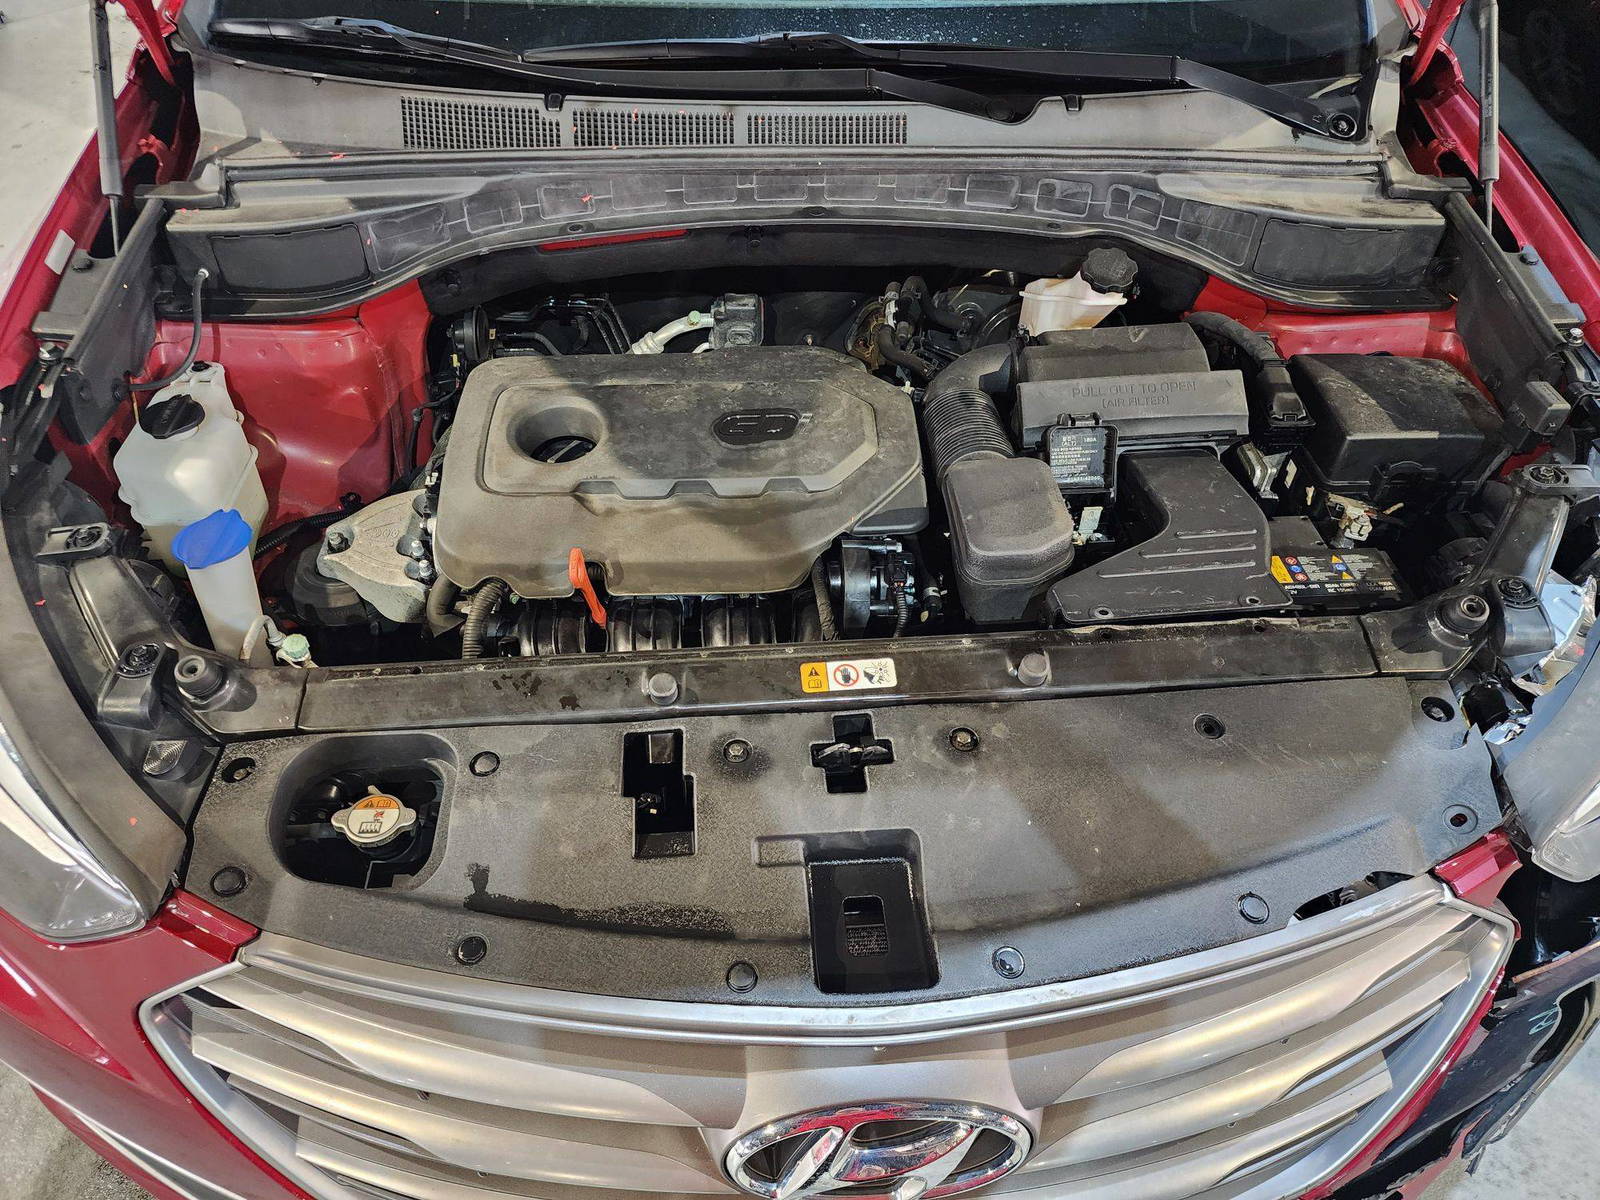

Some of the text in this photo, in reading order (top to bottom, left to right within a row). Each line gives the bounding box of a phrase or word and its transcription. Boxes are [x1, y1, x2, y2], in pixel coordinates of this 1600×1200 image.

[1072, 381, 1196, 398] PULL OUT TO OPEN
